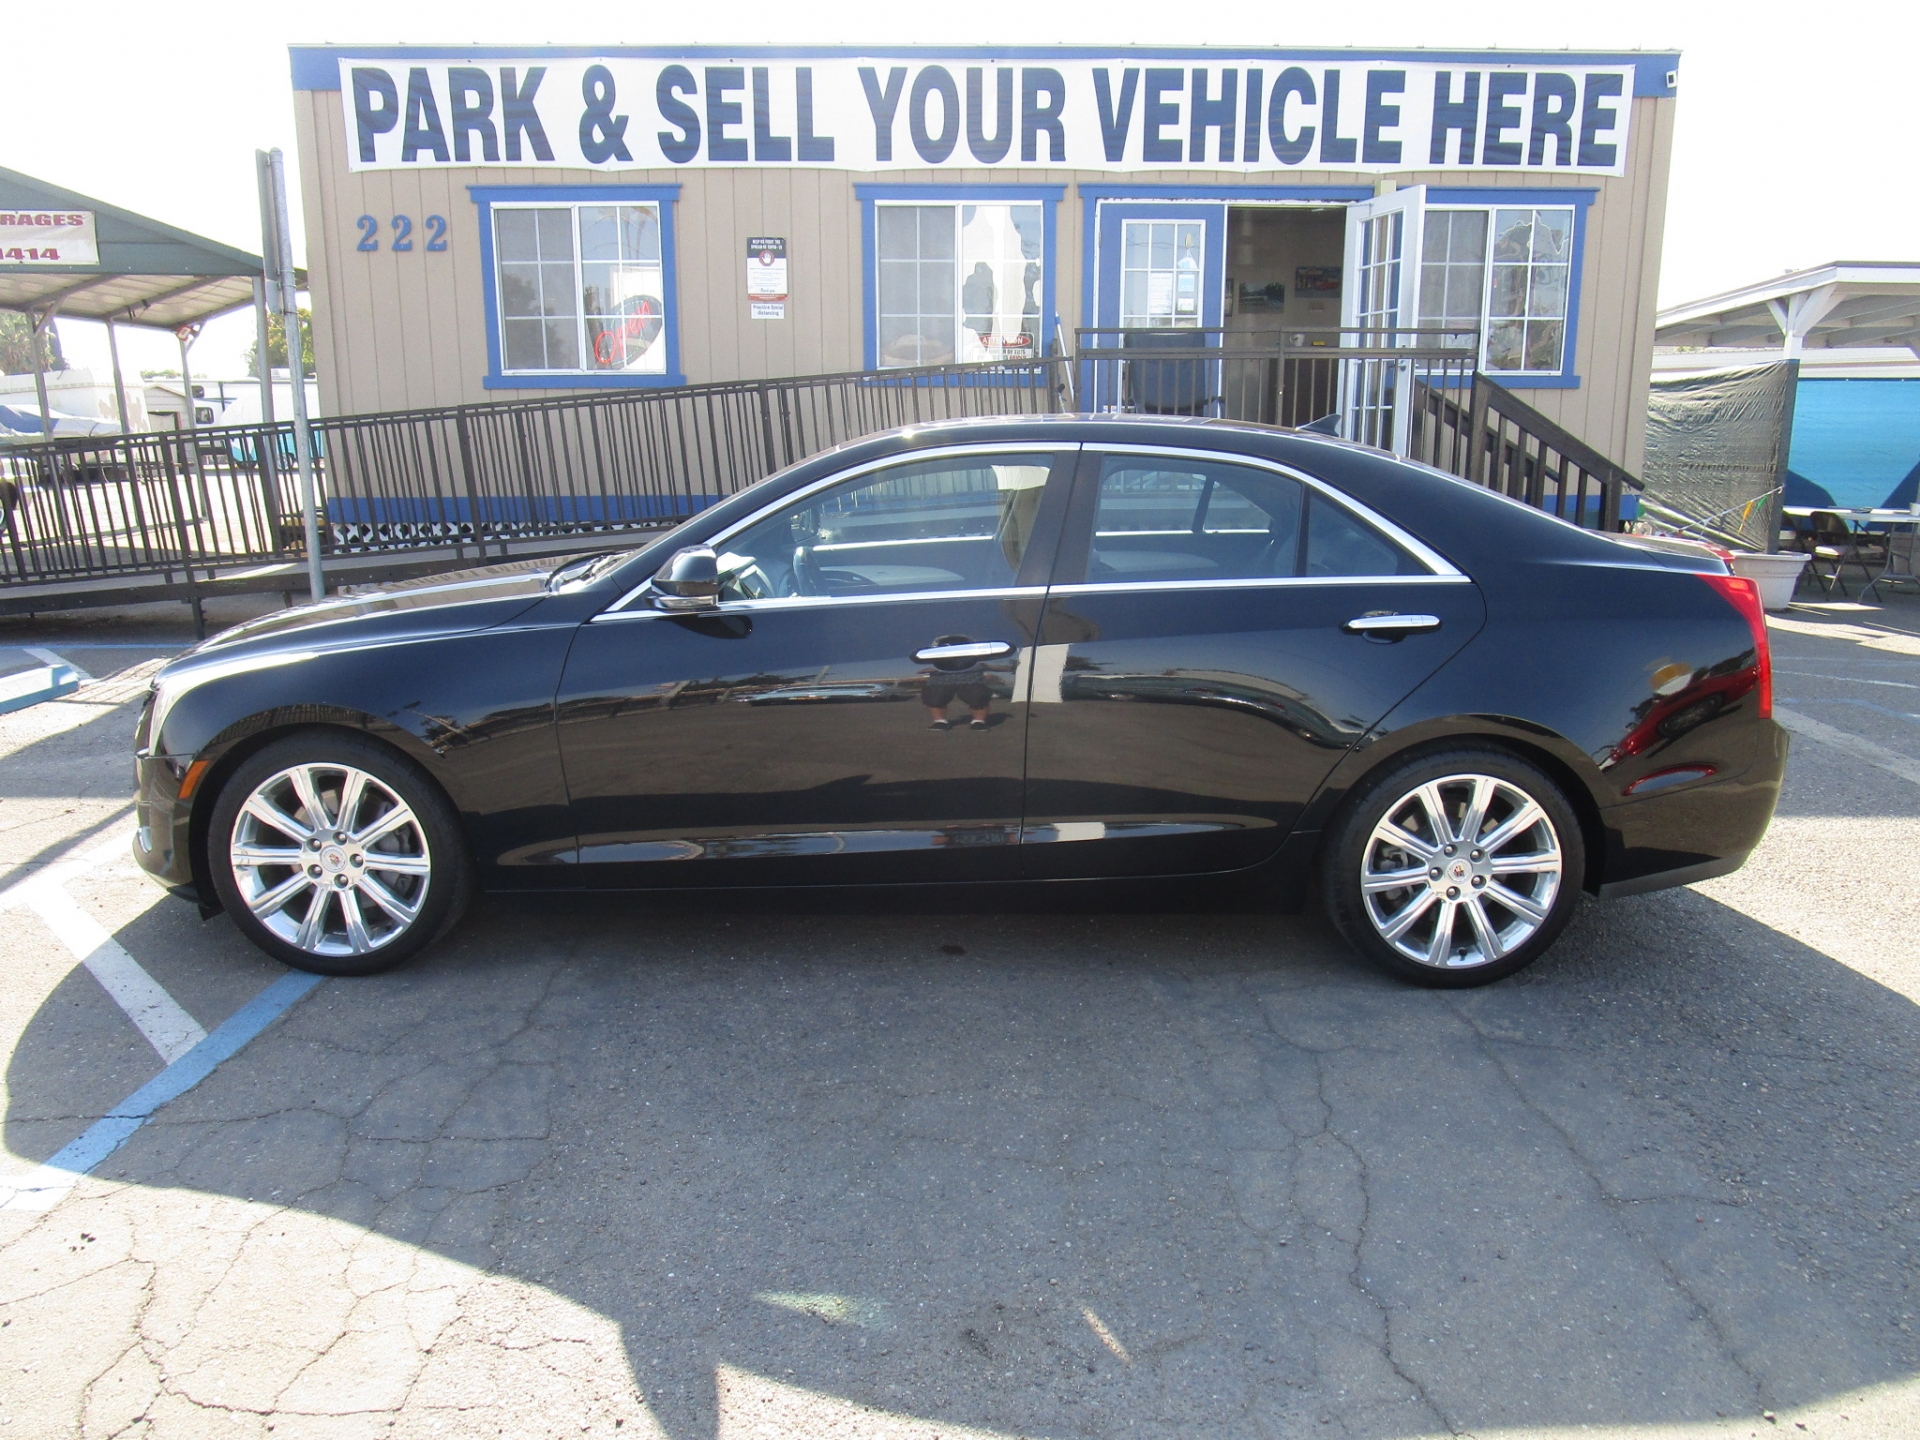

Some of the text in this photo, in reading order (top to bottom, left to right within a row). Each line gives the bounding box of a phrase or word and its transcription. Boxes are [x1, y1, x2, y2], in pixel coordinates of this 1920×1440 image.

[351, 64, 1625, 167] PARK & SELL YOUR VEHICLE HERE
[0, 214, 84, 226] RAGES
[356, 214, 448, 252] 222
[595, 300, 653, 365] Open
